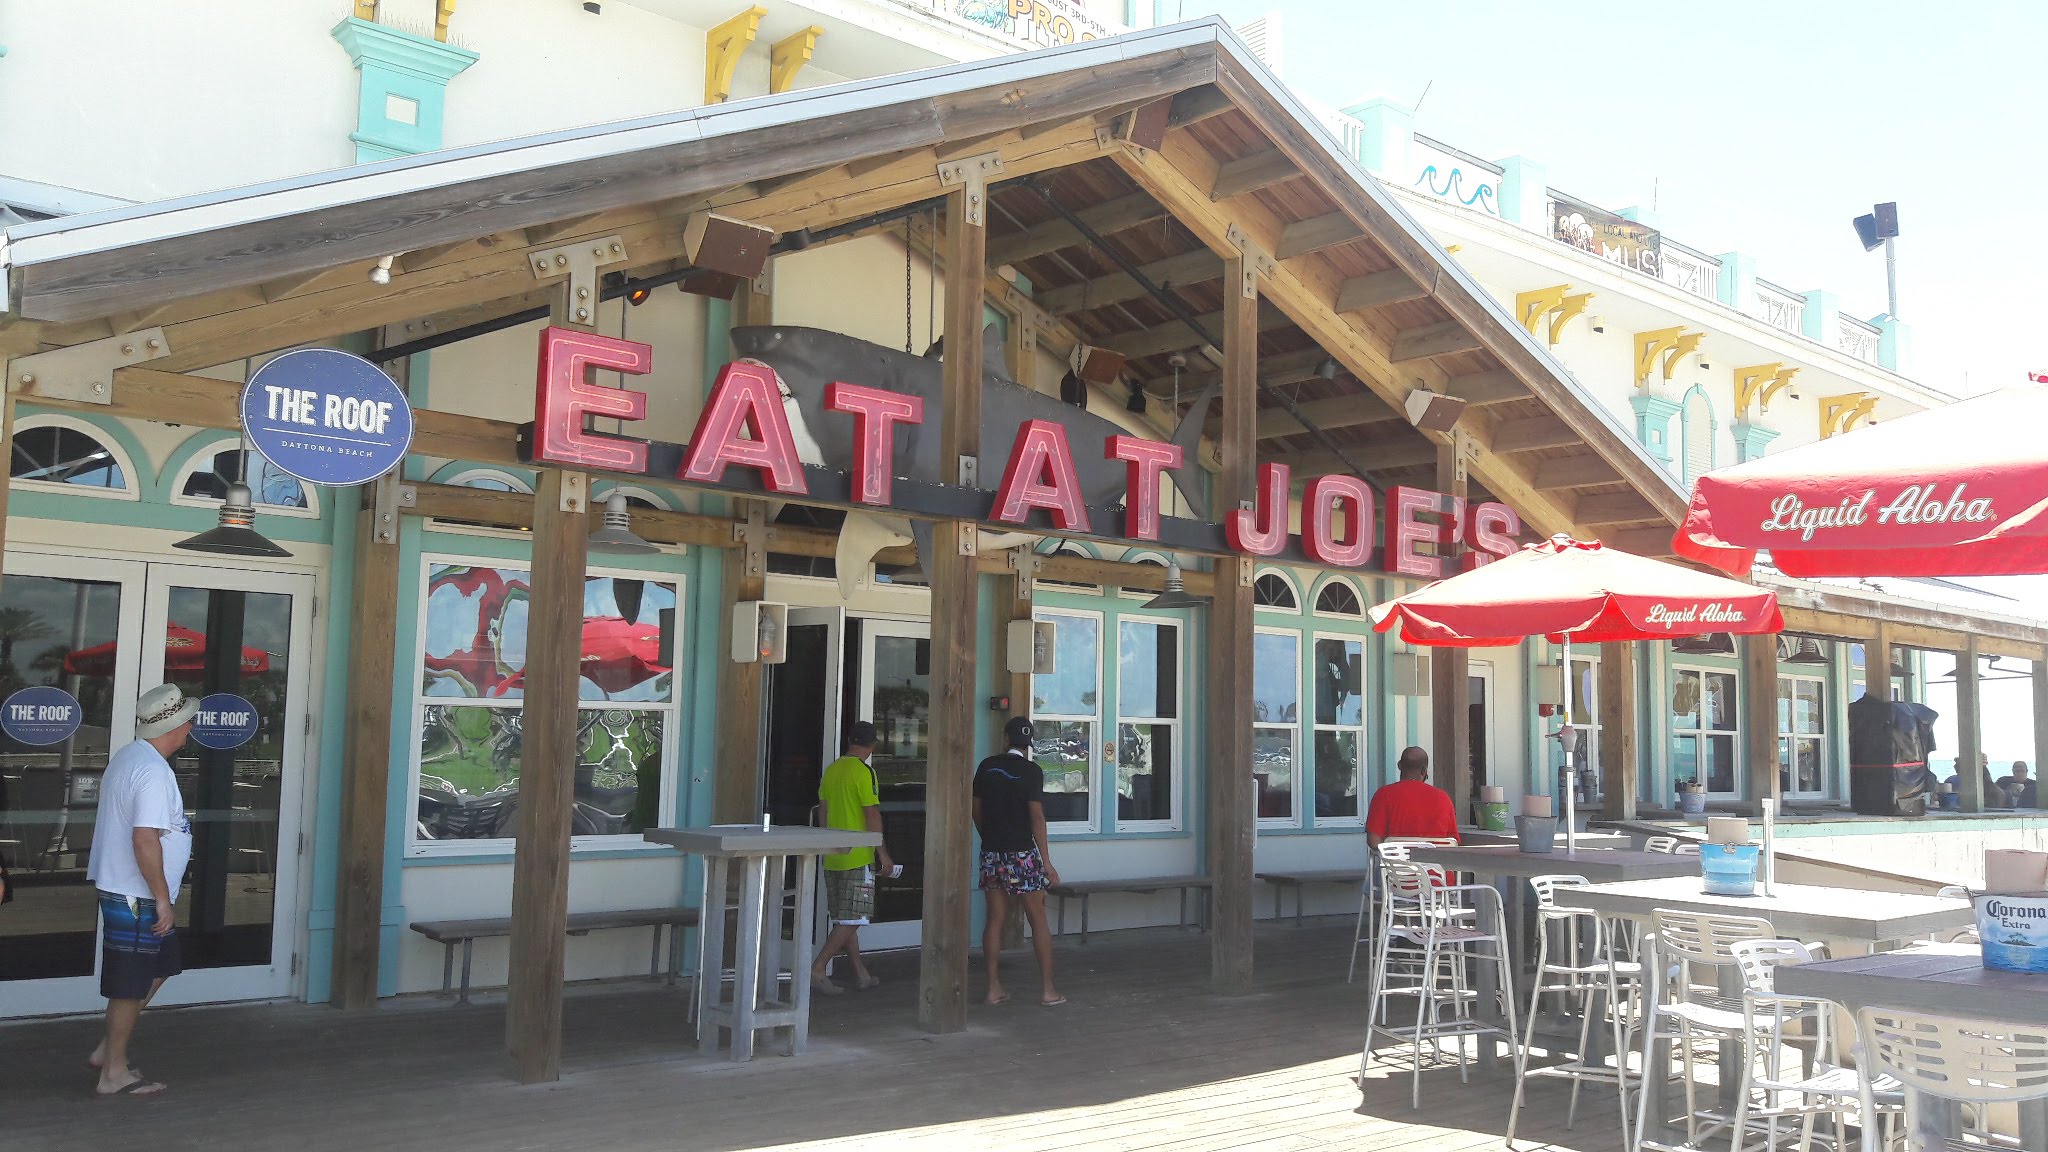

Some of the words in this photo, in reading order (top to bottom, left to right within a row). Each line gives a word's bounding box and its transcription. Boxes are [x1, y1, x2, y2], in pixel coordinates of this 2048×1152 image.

[1008, 0, 1075, 44] PRO
[265, 385, 318, 426] THE
[324, 394, 394, 435] ROOF
[281, 440, 333, 453] DAYTONA
[338, 447, 373, 458] BEACH
[533, 326, 925, 505] EAT
[988, 419, 1183, 541] AT
[1225, 462, 1520, 577] JOE'S
[1761, 489, 1876, 542] Liquid
[1877, 482, 1995, 524] Aloha
[1645, 603, 1698, 630] Liquid
[10, 704, 36, 720] THE
[38, 705, 73, 721] ROOF
[196, 710, 218, 725] THE
[220, 711, 250, 726] ROOF
[1986, 899, 2047, 920] Corona
[2002, 917, 2031, 930] Extra
